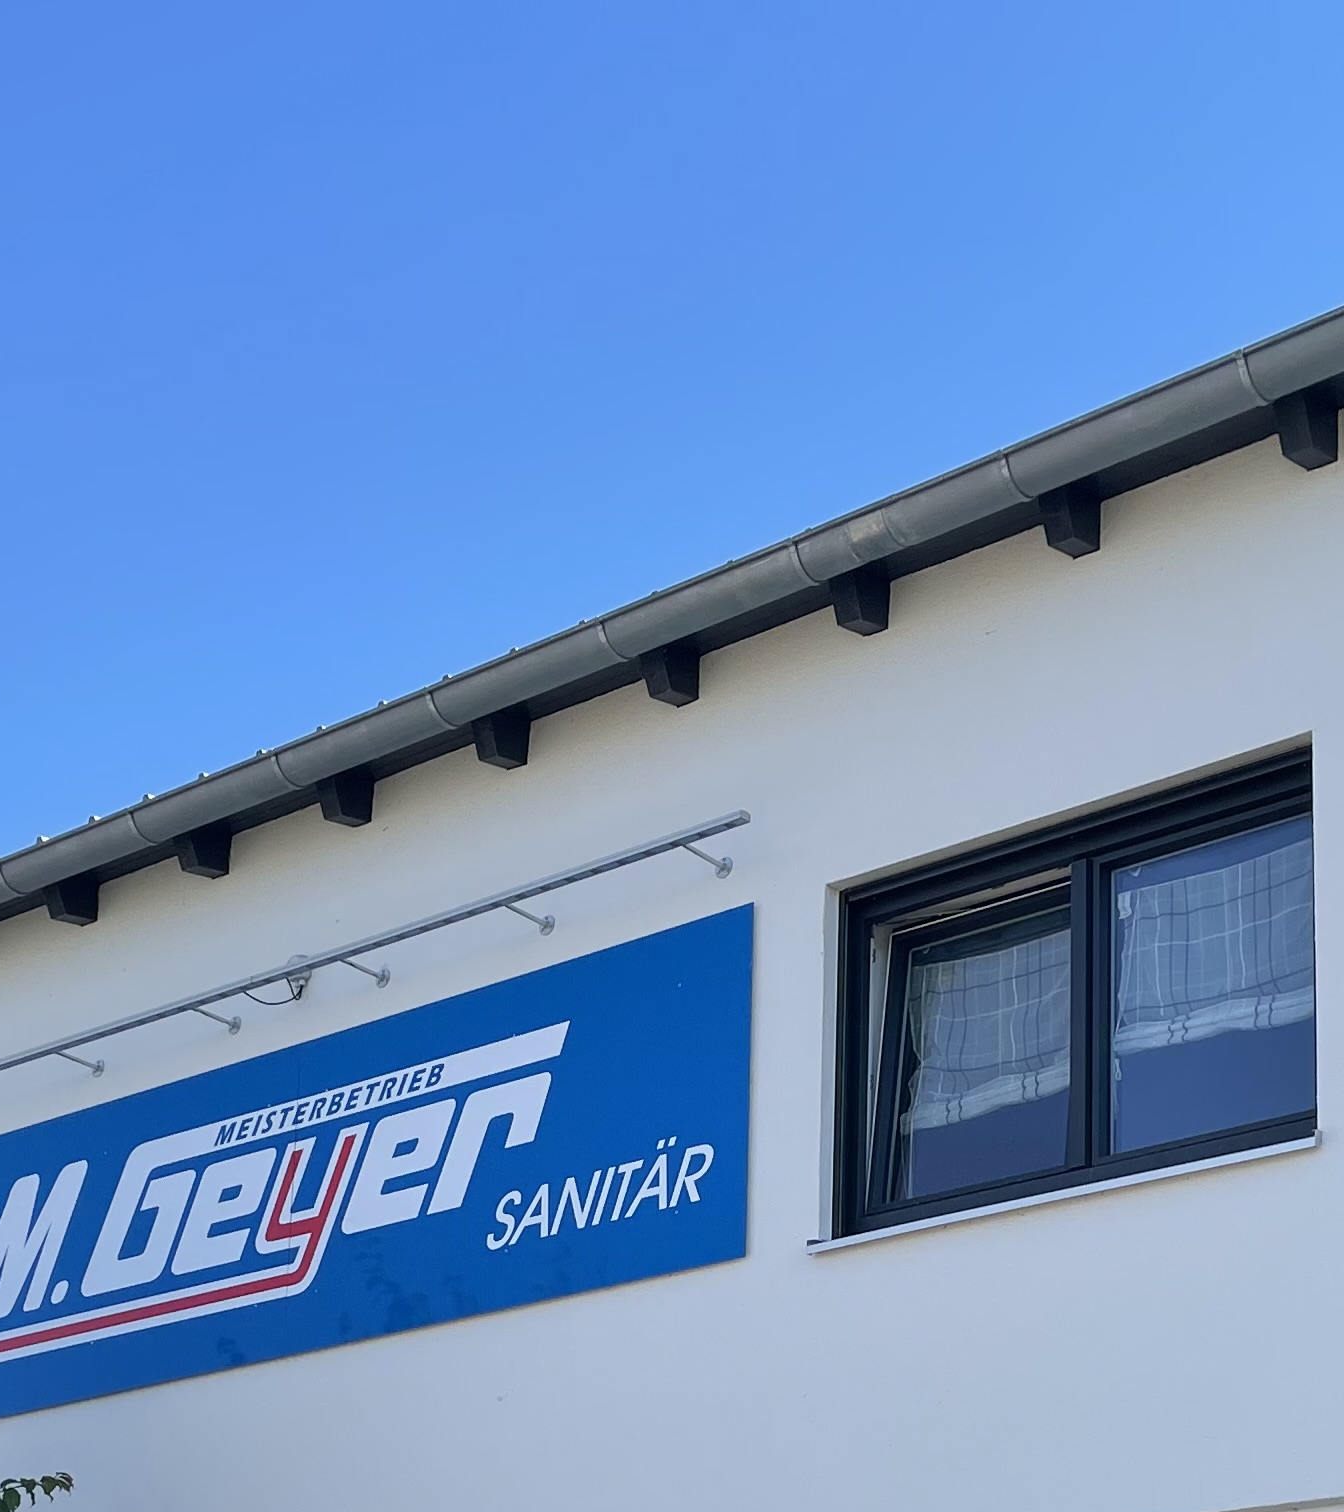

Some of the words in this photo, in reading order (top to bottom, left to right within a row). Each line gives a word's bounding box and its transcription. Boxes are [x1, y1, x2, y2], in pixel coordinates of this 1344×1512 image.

[214, 1063, 446, 1146] MEISTERBETRIEB
[81, 1070, 553, 1297] Geyer
[485, 1136, 715, 1252] SANITÄR
